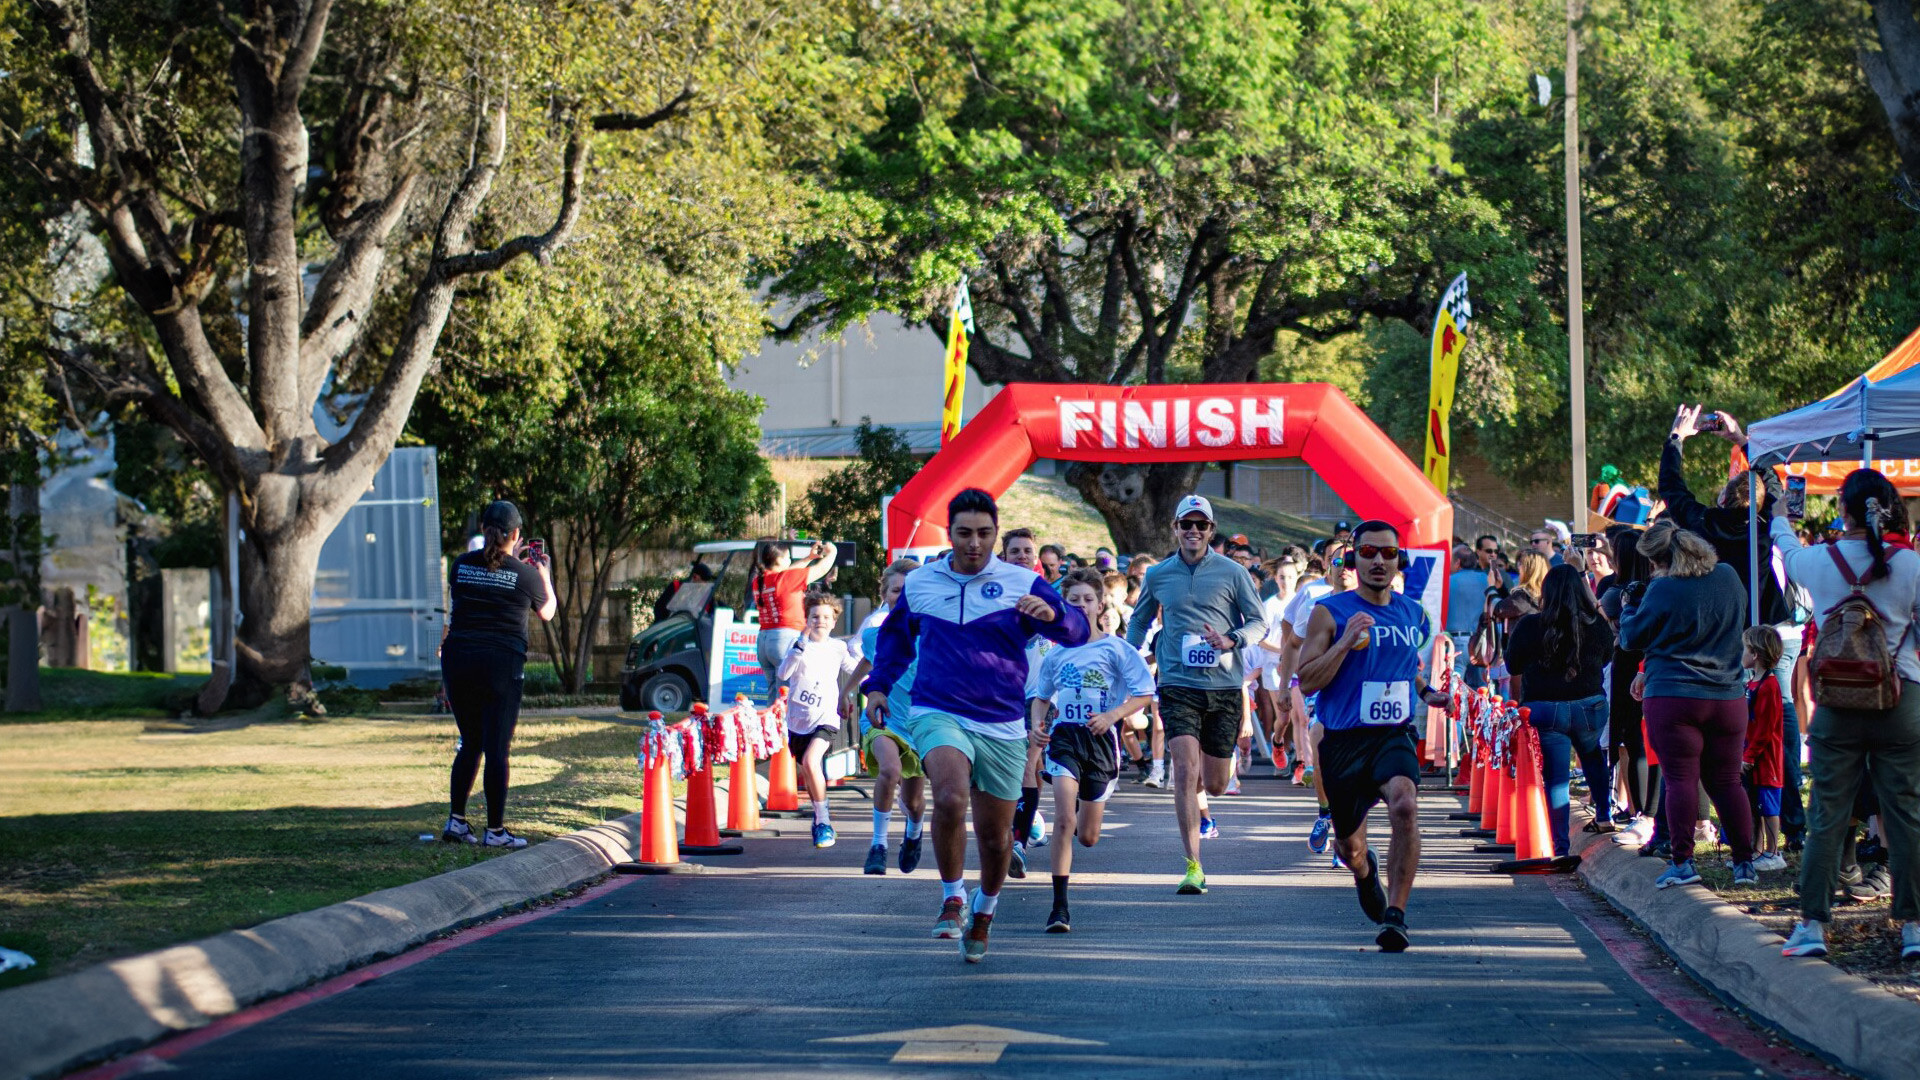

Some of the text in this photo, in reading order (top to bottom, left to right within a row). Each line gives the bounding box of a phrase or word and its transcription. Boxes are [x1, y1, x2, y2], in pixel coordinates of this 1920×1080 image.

[1060, 398, 1284, 448] FINISH
[458, 568, 486, 577] PROVEN
[487, 572, 517, 582] RESULTS
[1188, 649, 1215, 664] 666
[799, 690, 822, 708] 661
[1065, 703, 1093, 720] 613
[1369, 701, 1403, 721] 696
